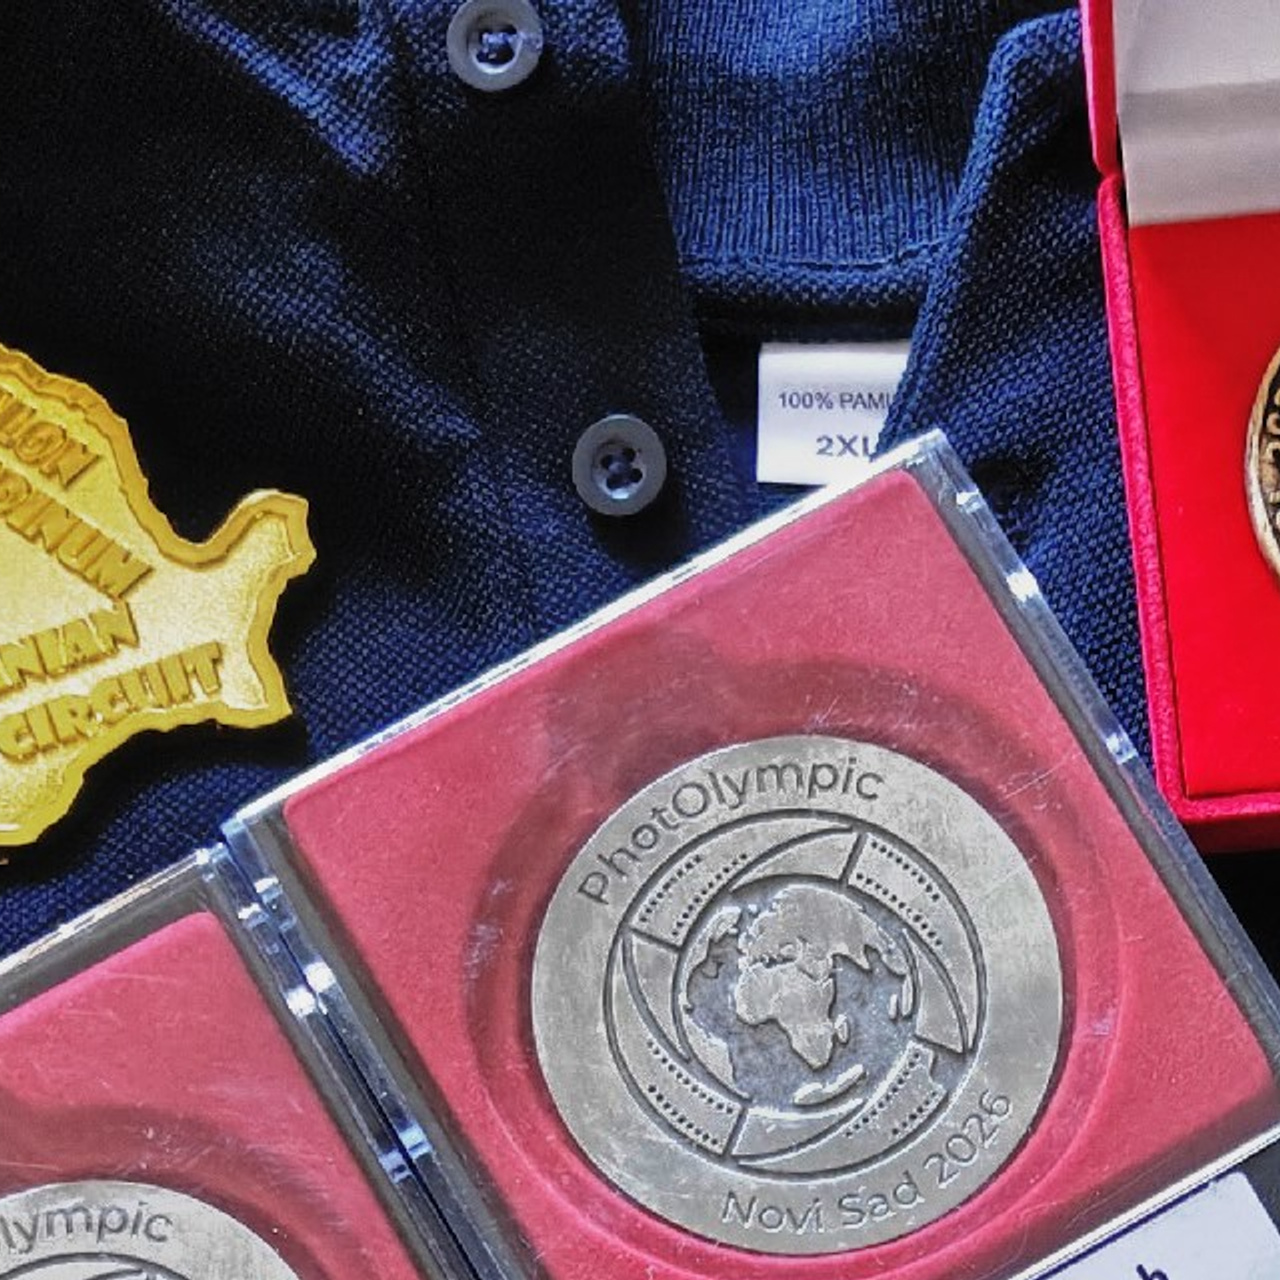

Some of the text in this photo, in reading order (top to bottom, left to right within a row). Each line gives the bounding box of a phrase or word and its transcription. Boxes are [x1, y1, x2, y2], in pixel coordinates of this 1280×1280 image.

[0, 386, 103, 490] ION
[778, 392, 834, 410] 100%
[0, 600, 139, 695] NIAN
[0, 641, 223, 765] CIRCUIT
[577, 755, 885, 907] PhotOlympic
[720, 1089, 1013, 1235] Novi Sad 2026
